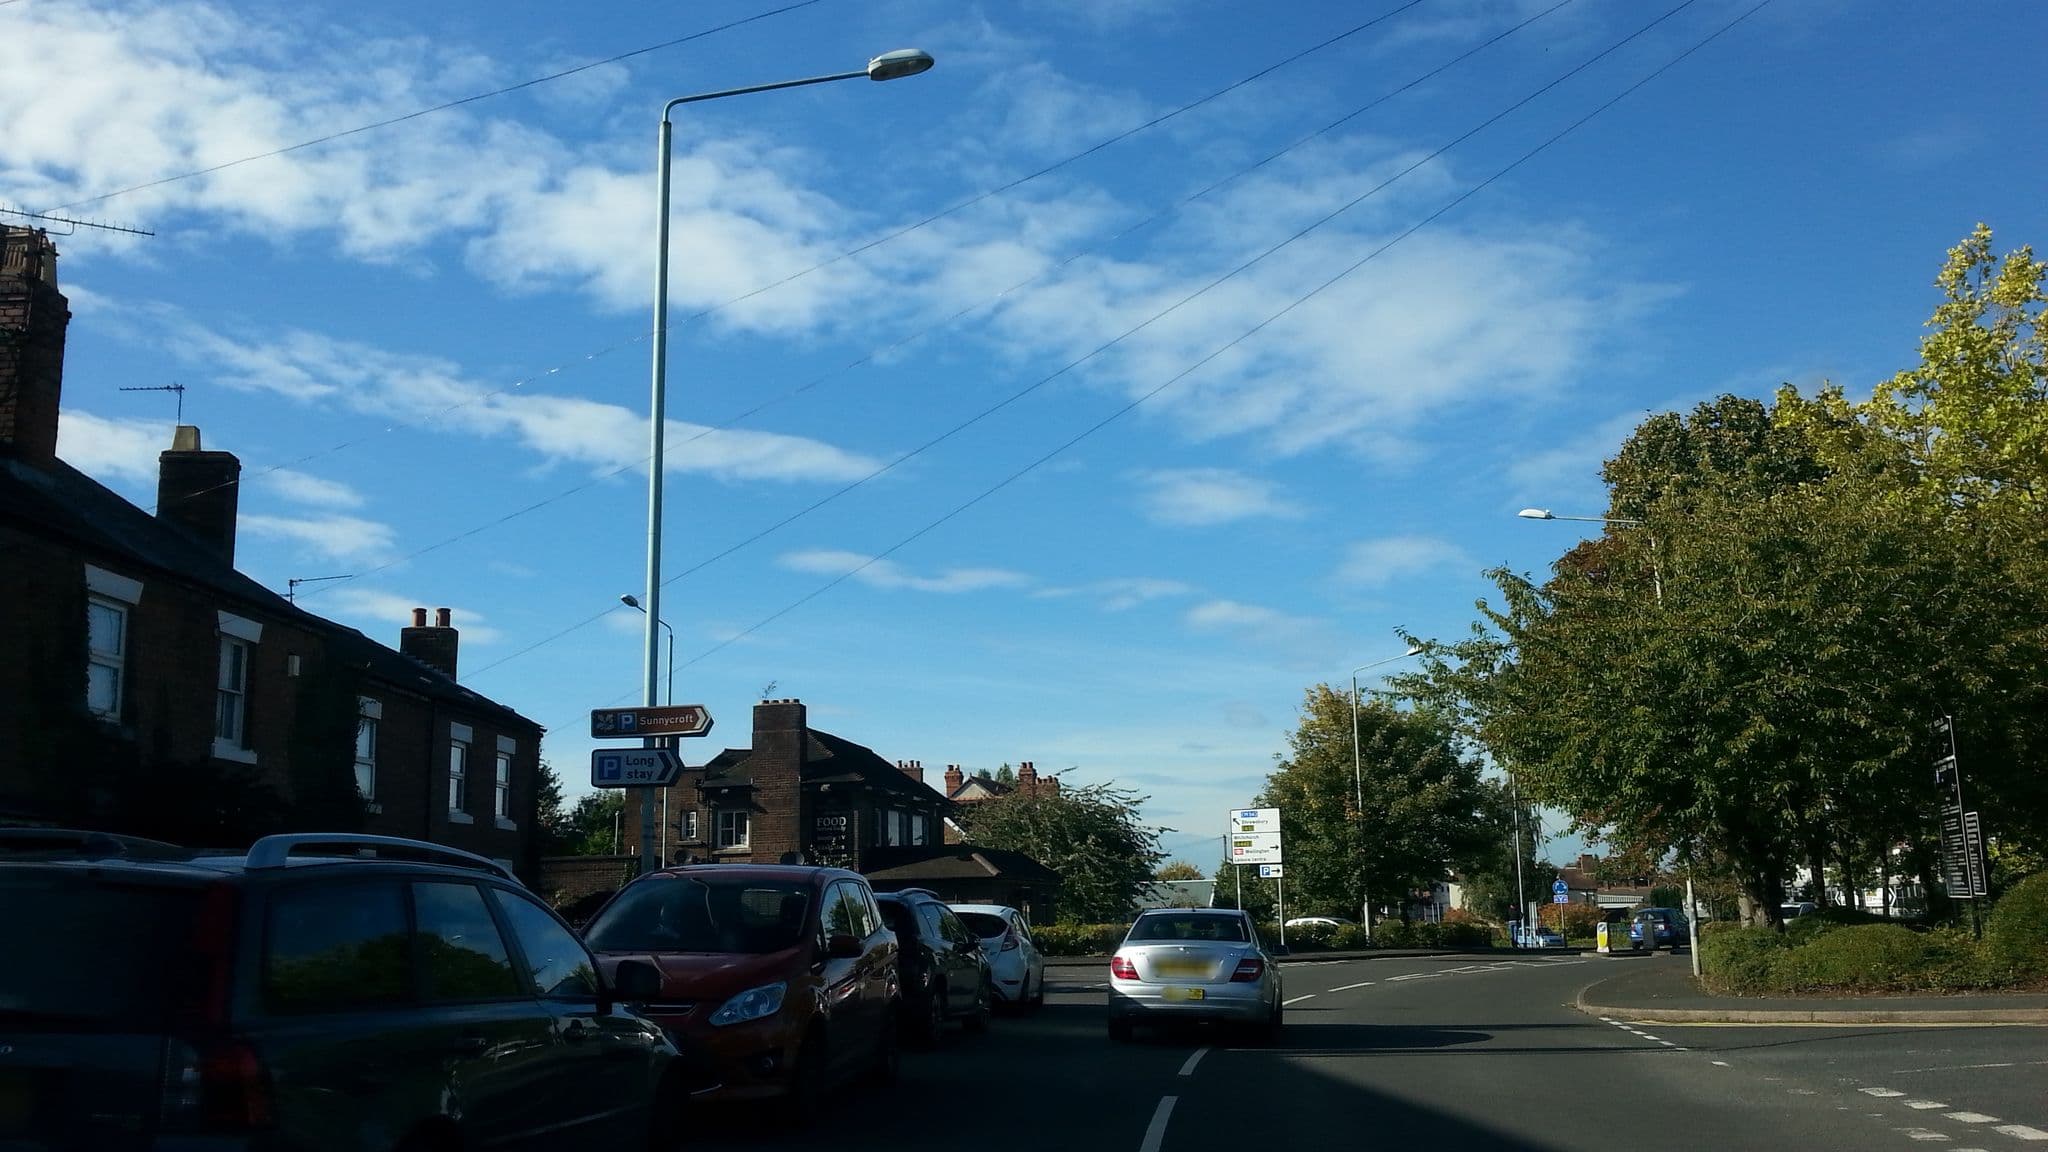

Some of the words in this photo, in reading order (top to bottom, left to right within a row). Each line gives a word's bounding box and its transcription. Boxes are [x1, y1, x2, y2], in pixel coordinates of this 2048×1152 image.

[622, 715, 633, 729] P
[640, 714, 694, 726] Sunnycroft
[626, 756, 654, 766] Long
[607, 759, 617, 777] P
[625, 769, 653, 779] stay
[816, 816, 847, 827] FOOD
